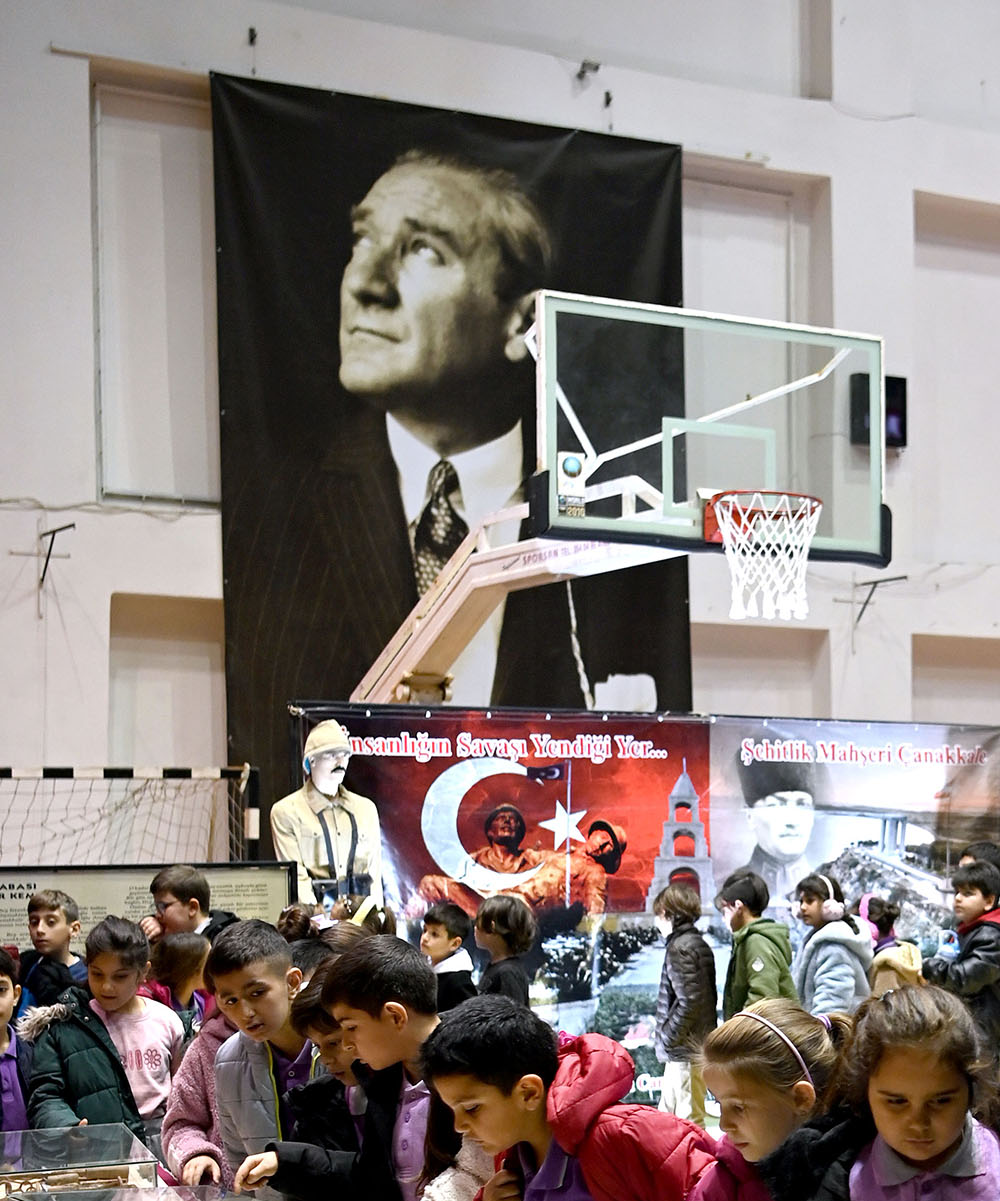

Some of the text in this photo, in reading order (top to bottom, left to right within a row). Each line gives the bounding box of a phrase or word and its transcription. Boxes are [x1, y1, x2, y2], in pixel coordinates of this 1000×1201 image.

[345, 731, 668, 764] nsanlığın Savaşı Yendiği Yer...
[741, 738, 988, 767] Şehitlik Mahşeri Çanakkale
